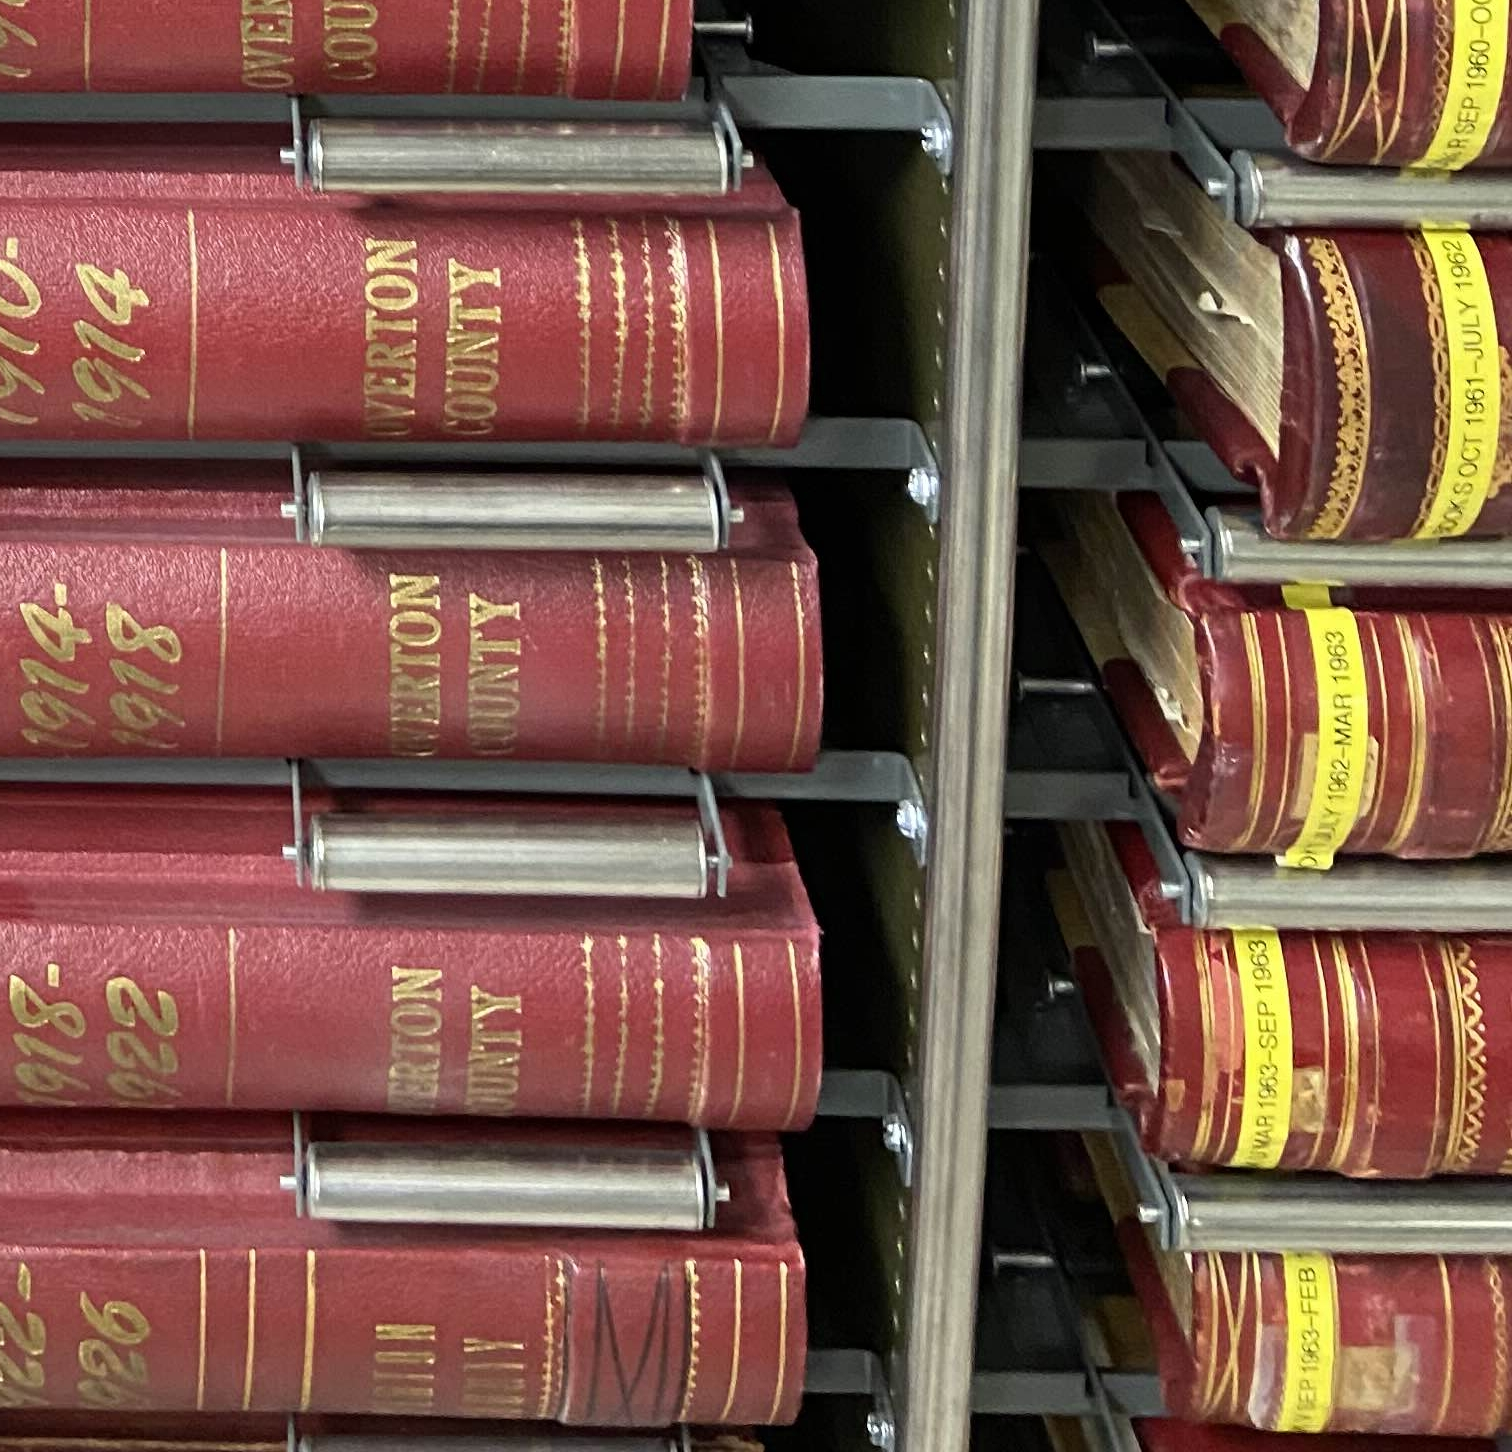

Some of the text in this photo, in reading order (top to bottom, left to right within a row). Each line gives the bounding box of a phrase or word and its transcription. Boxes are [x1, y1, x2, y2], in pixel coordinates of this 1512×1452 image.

[1453, 96, 1480, 134] SEP
[1442, 239, 1472, 292] 1962
[72, 262, 151, 428] 1914
[444, 257, 502, 435] COUNTY
[1458, 435, 1482, 478] OCT
[19, 582, 97, 748] 1914-
[105, 601, 186, 748] 1918
[1324, 630, 1347, 684] 1963
[1248, 939, 1274, 992] 1963
